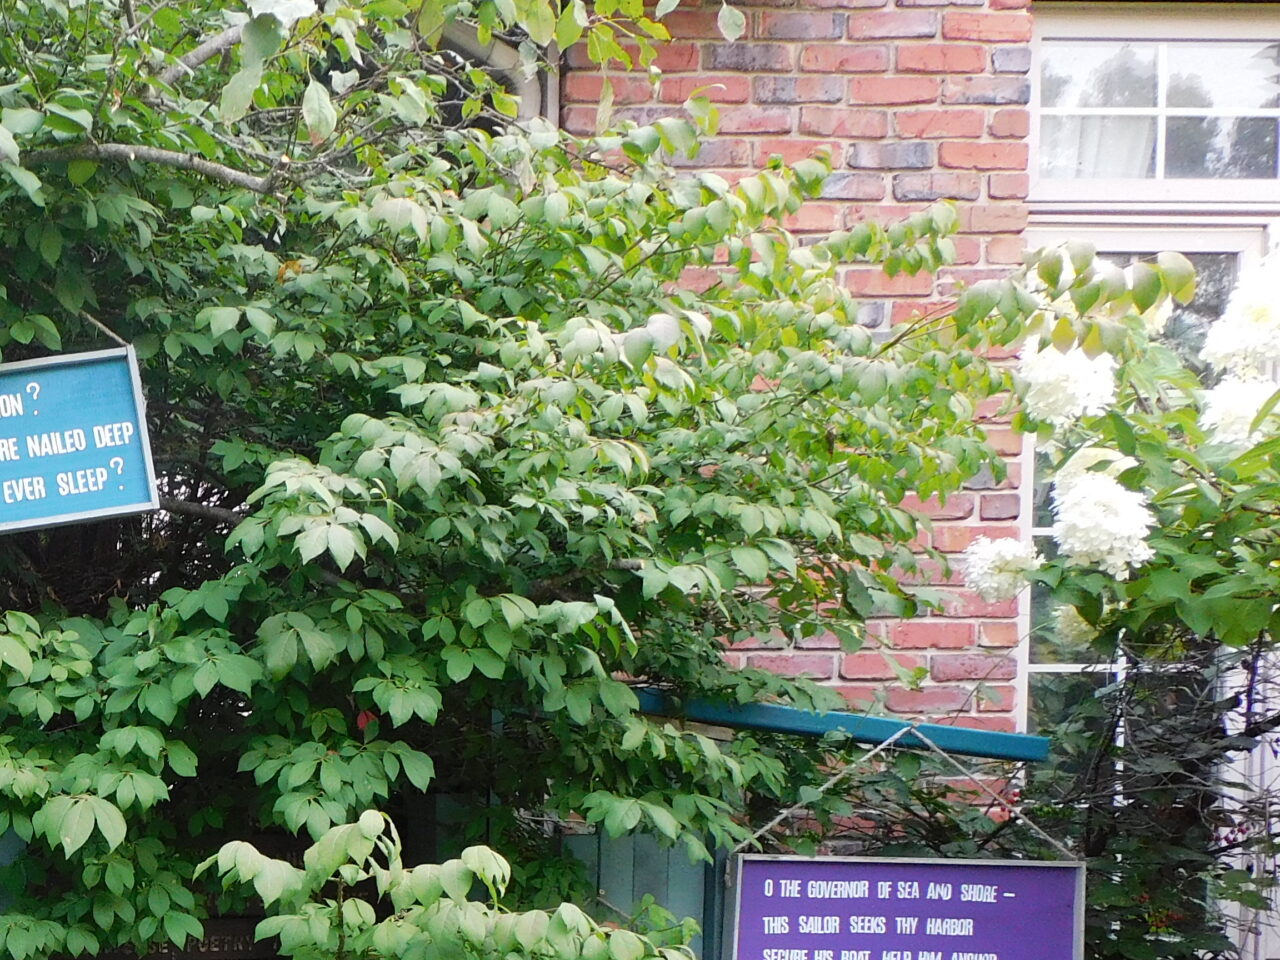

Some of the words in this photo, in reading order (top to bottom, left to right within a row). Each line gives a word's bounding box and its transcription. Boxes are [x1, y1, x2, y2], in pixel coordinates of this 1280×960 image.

[26, 430, 87, 458] NAILED
[92, 421, 134, 449] DEEP
[2, 476, 47, 504] EVER
[764, 878, 774, 897] O
[779, 879, 802, 898] THE
[807, 880, 869, 899] GOVERNOR
[877, 881, 893, 899] OF
[896, 881, 920, 899] SEA
[926, 882, 952, 901] AND
[960, 884, 998, 903] SHORE
[762, 916, 790, 935] THIS
[798, 915, 840, 934] SAILOR
[849, 915, 887, 934] SEEKS
[895, 917, 919, 935] THY
[926, 917, 974, 936] HARBOR
